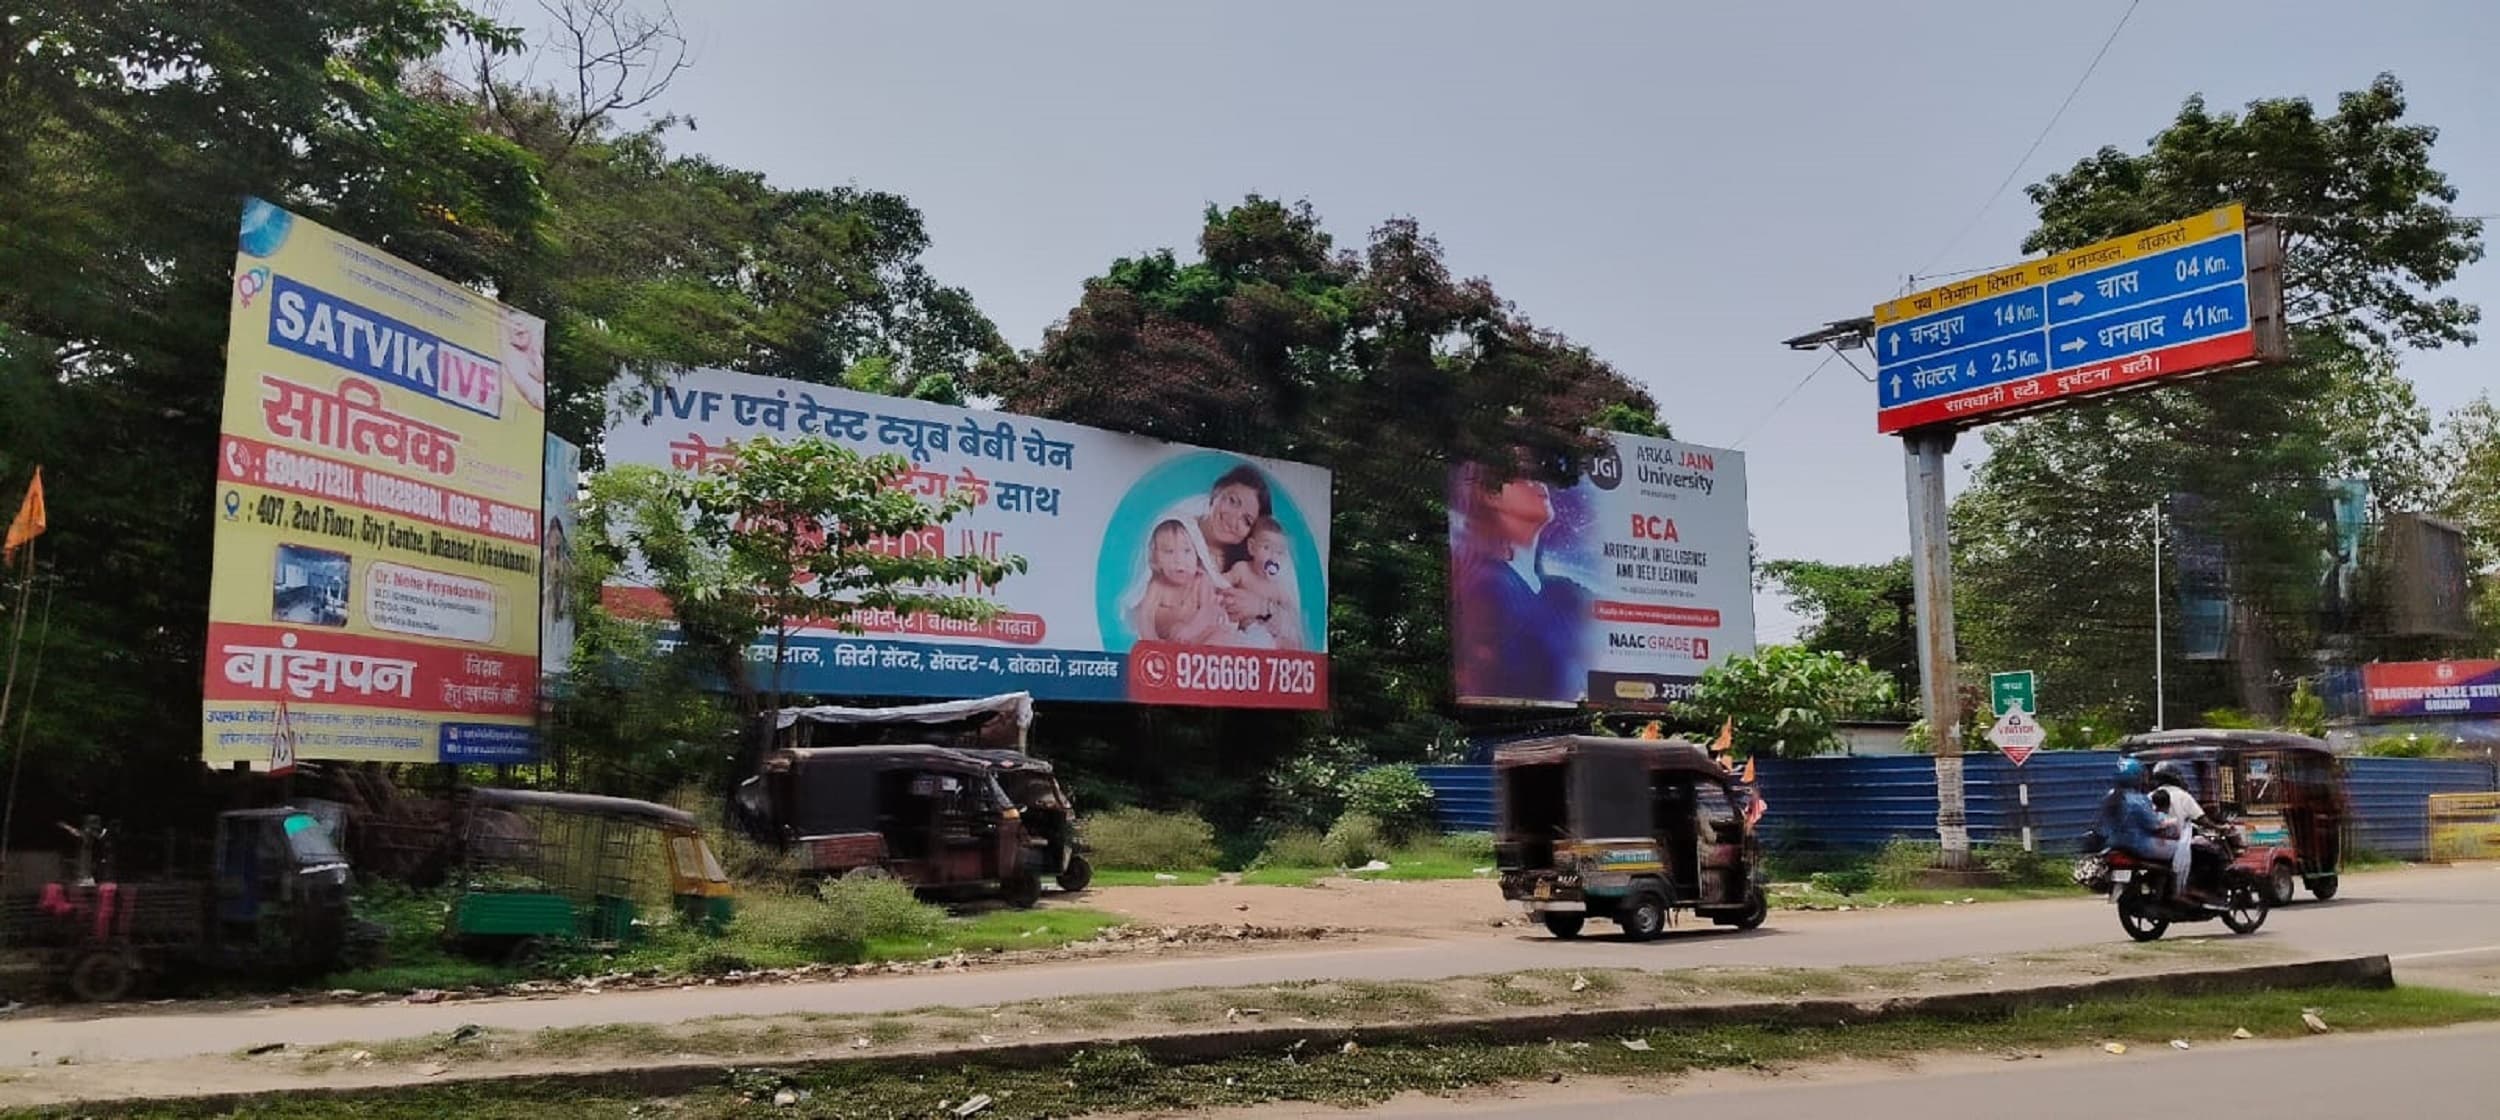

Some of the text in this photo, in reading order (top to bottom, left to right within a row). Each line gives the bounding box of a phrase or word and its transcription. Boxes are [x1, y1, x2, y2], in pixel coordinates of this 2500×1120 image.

[1939, 281, 1979, 306] निर्माण
[2137, 225, 2186, 252] बोकारो
[2097, 255, 2230, 299] चास 04 Km.
[1910, 303, 2038, 346] चन्द्रपुरा 14 Km.
[2098, 305, 2233, 348] धनबाद 41 Km.
[276, 291, 434, 388] SATVIK
[438, 350, 496, 406] IVF
[1912, 365, 1957, 390] सेक्टर
[1966, 360, 1977, 378] 4
[1991, 350, 2017, 374] 2.5
[1945, 387, 2004, 412] सावधानी
[2057, 367, 2111, 394] दुर्घटना
[261, 375, 461, 475] सात्विक
[653, 386, 1075, 470] IVF एवं टेस्ट ट्यूब बेबी चेन
[1637, 446, 1714, 471] ARKA JAIN
[995, 480, 1060, 516] साथ
[1638, 465, 1714, 496] University
[292, 501, 320, 532] 2nd
[1632, 514, 1679, 542] BCA
[1603, 542, 1707, 567] ARTIFICIAL INTELLIGENCE
[1616, 563, 1698, 585] AND DEEP LEARNING
[223, 632, 418, 698] बांझपन
[836, 643, 876, 666] सिटी
[880, 646, 925, 672] सेंटर,
[929, 650, 1005, 676] सेक्टर-4,
[1008, 651, 1065, 677] बोकारो,
[1068, 656, 1119, 678] झारखंड
[1609, 633, 1645, 649] NAAC
[1648, 636, 1690, 652] GRADE
[1695, 641, 1707, 657] A
[1176, 653, 1315, 694] 926668 7826
[2426, 685, 2469, 698] POLICE
